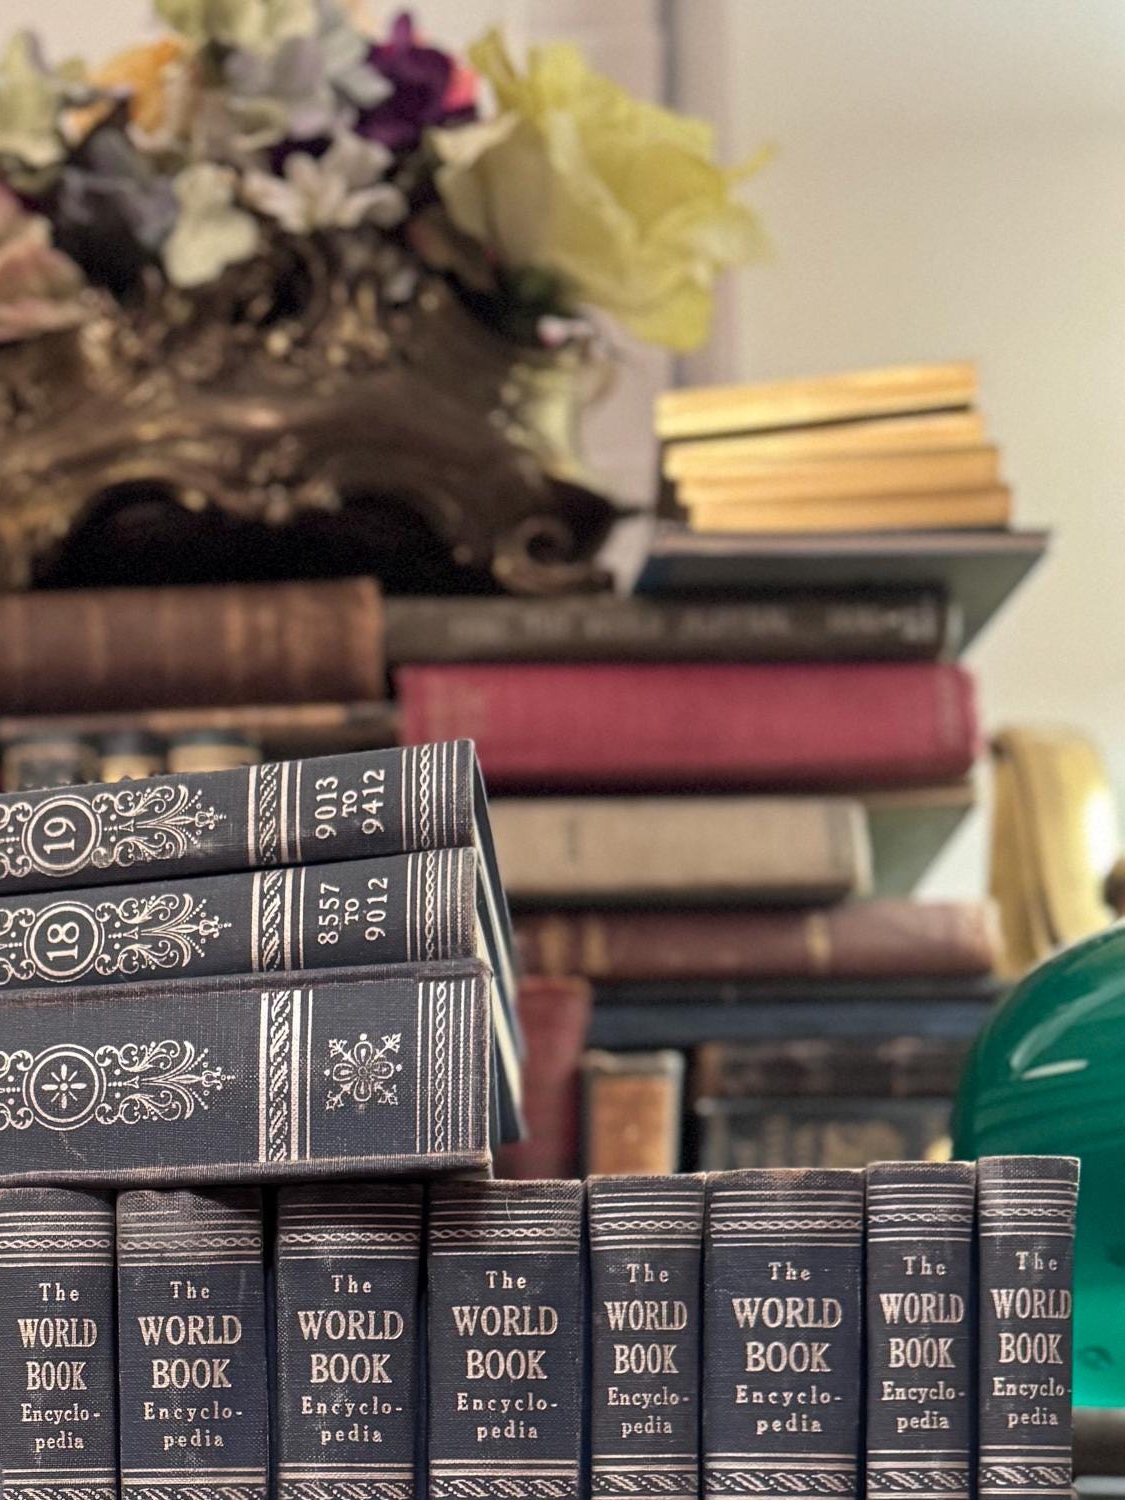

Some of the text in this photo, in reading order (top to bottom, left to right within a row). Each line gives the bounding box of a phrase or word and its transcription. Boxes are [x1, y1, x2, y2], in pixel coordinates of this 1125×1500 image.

[315, 777, 338, 838] 9013
[342, 791, 357, 817] TO
[362, 770, 384, 833] 9412
[43, 817, 76, 854] 19
[318, 883, 339, 944] 8557
[345, 899, 359, 925] TO
[365, 878, 388, 940] 9012
[47, 922, 79, 960] 18
[769, 1262, 810, 1280] The
[1016, 1252, 1056, 1270] The
[170, 1281, 209, 1298] The
[486, 1271, 526, 1288] The
[604, 1300, 687, 1330] WORLD
[880, 1293, 963, 1323] WORLD
[18, 1318, 97, 1347] WORLD
[298, 1310, 403, 1340] WORLD
[746, 1342, 831, 1372] BOOK
[999, 1333, 1062, 1363] BOOK
[152, 1359, 231, 1388] BOOK
[466, 1349, 547, 1379] BOOK
[608, 1387, 688, 1409] Encyclo-
[881, 1381, 965, 1403] Encyclo-
[21, 1403, 100, 1424] Encyclo-
[302, 1396, 402, 1417] Encyclo-
[1008, 1407, 1058, 1428] pedia
[477, 1420, 537, 1441] pedia
[757, 1413, 822, 1434] pedia
[164, 1429, 223, 1450] pedia
